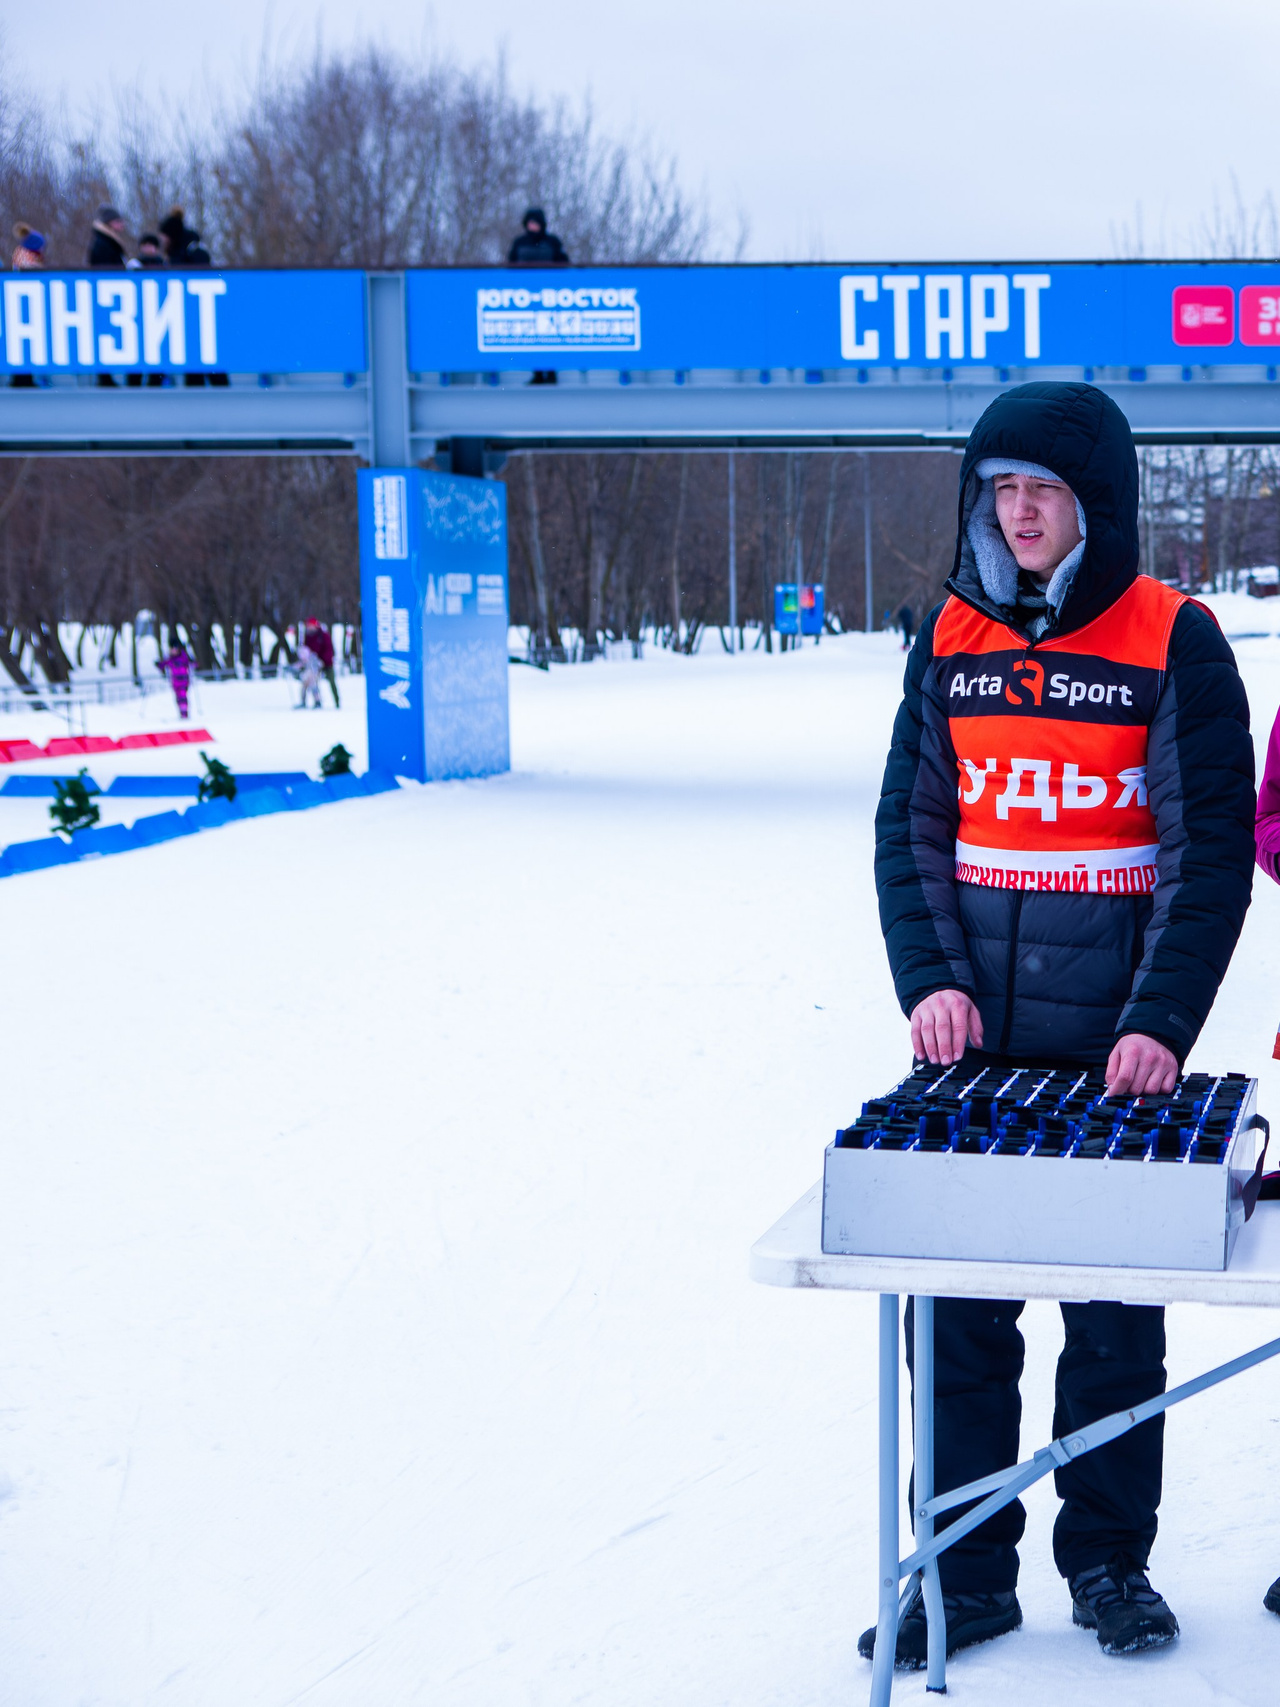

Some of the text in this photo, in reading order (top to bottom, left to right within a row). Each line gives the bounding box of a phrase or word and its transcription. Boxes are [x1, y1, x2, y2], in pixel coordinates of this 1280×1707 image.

[0, 279, 226, 366] АНЗИТ
[477, 288, 637, 309] ЮГО-ВОСТОК
[840, 274, 1051, 360] СТАРТ
[950, 673, 1133, 706] Arta Sport
[958, 757, 1148, 822] УДЬЯ
[1097, 864, 1157, 893] СПОР
